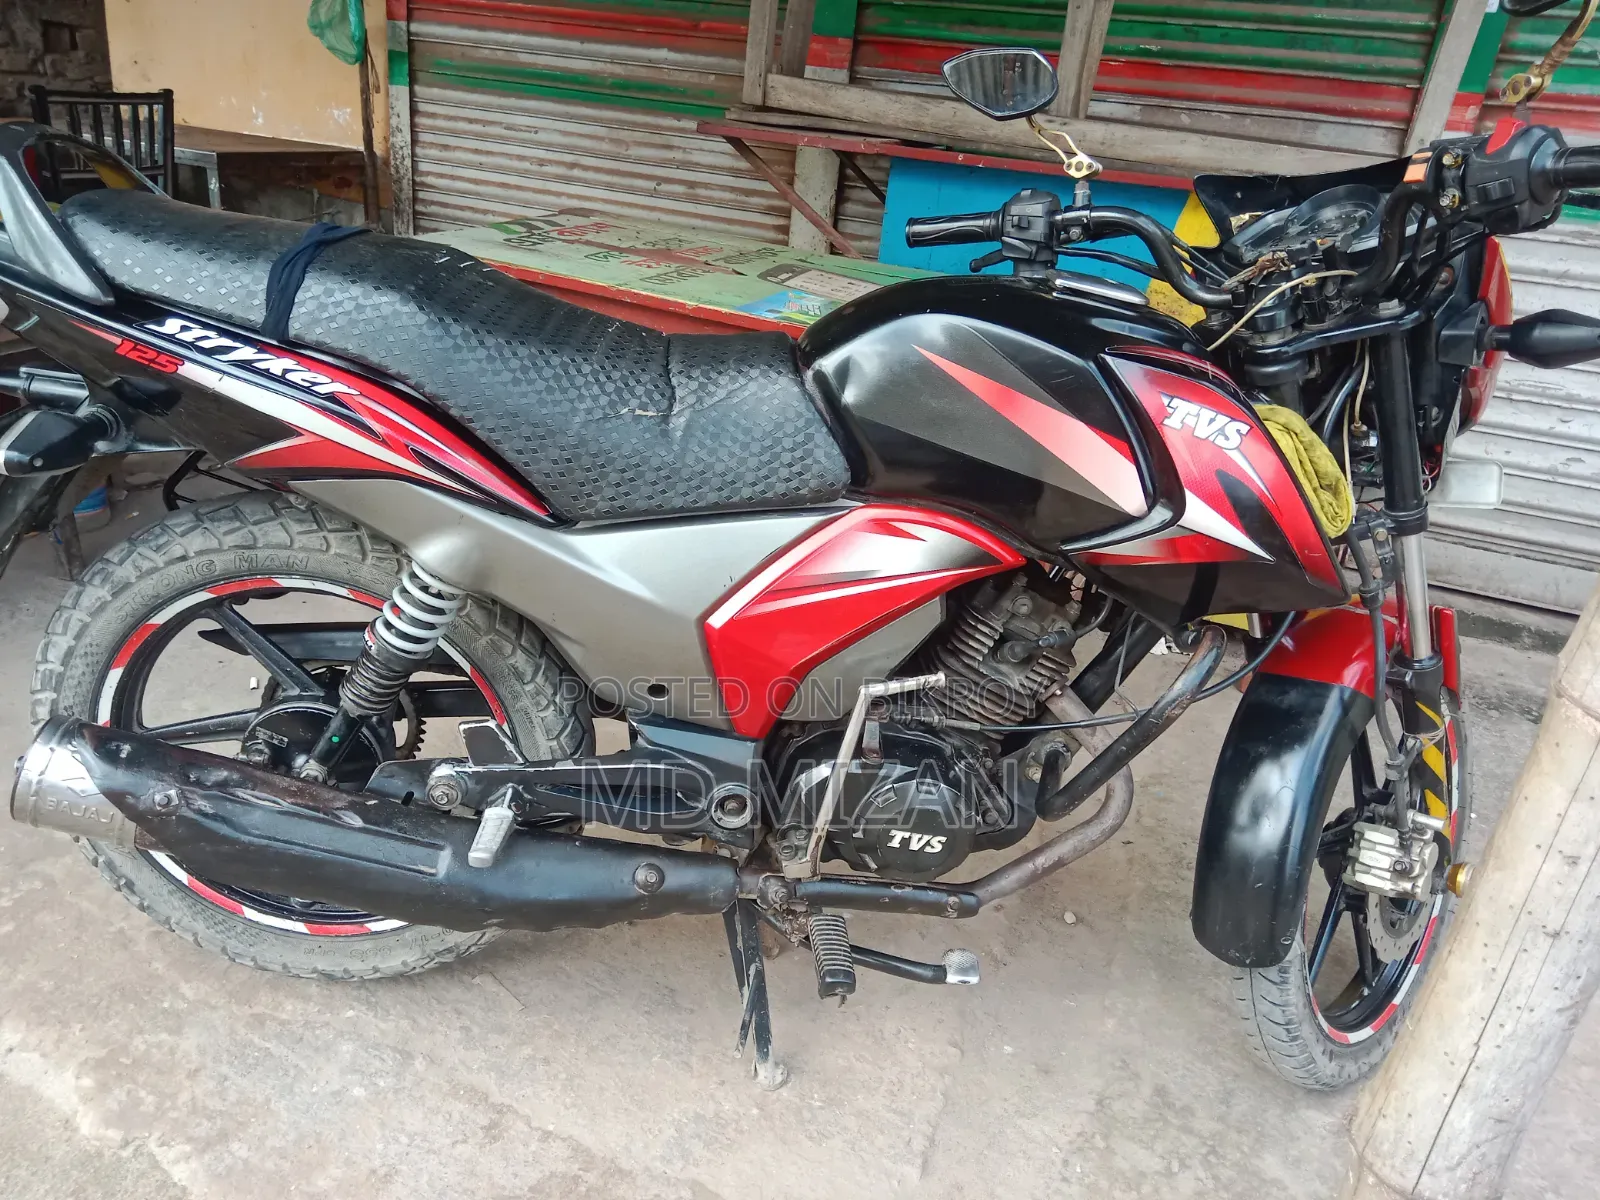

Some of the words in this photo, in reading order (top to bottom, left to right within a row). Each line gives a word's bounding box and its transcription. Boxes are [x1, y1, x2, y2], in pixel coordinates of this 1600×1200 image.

[114, 339, 184, 374] 125
[144, 318, 360, 397] Stryker
[1161, 397, 1253, 450] TVS
[114, 559, 217, 625] STRONG
[233, 552, 309, 571] MAN
[46, 797, 115, 823] BAJAJ
[886, 829, 948, 853] TVS
